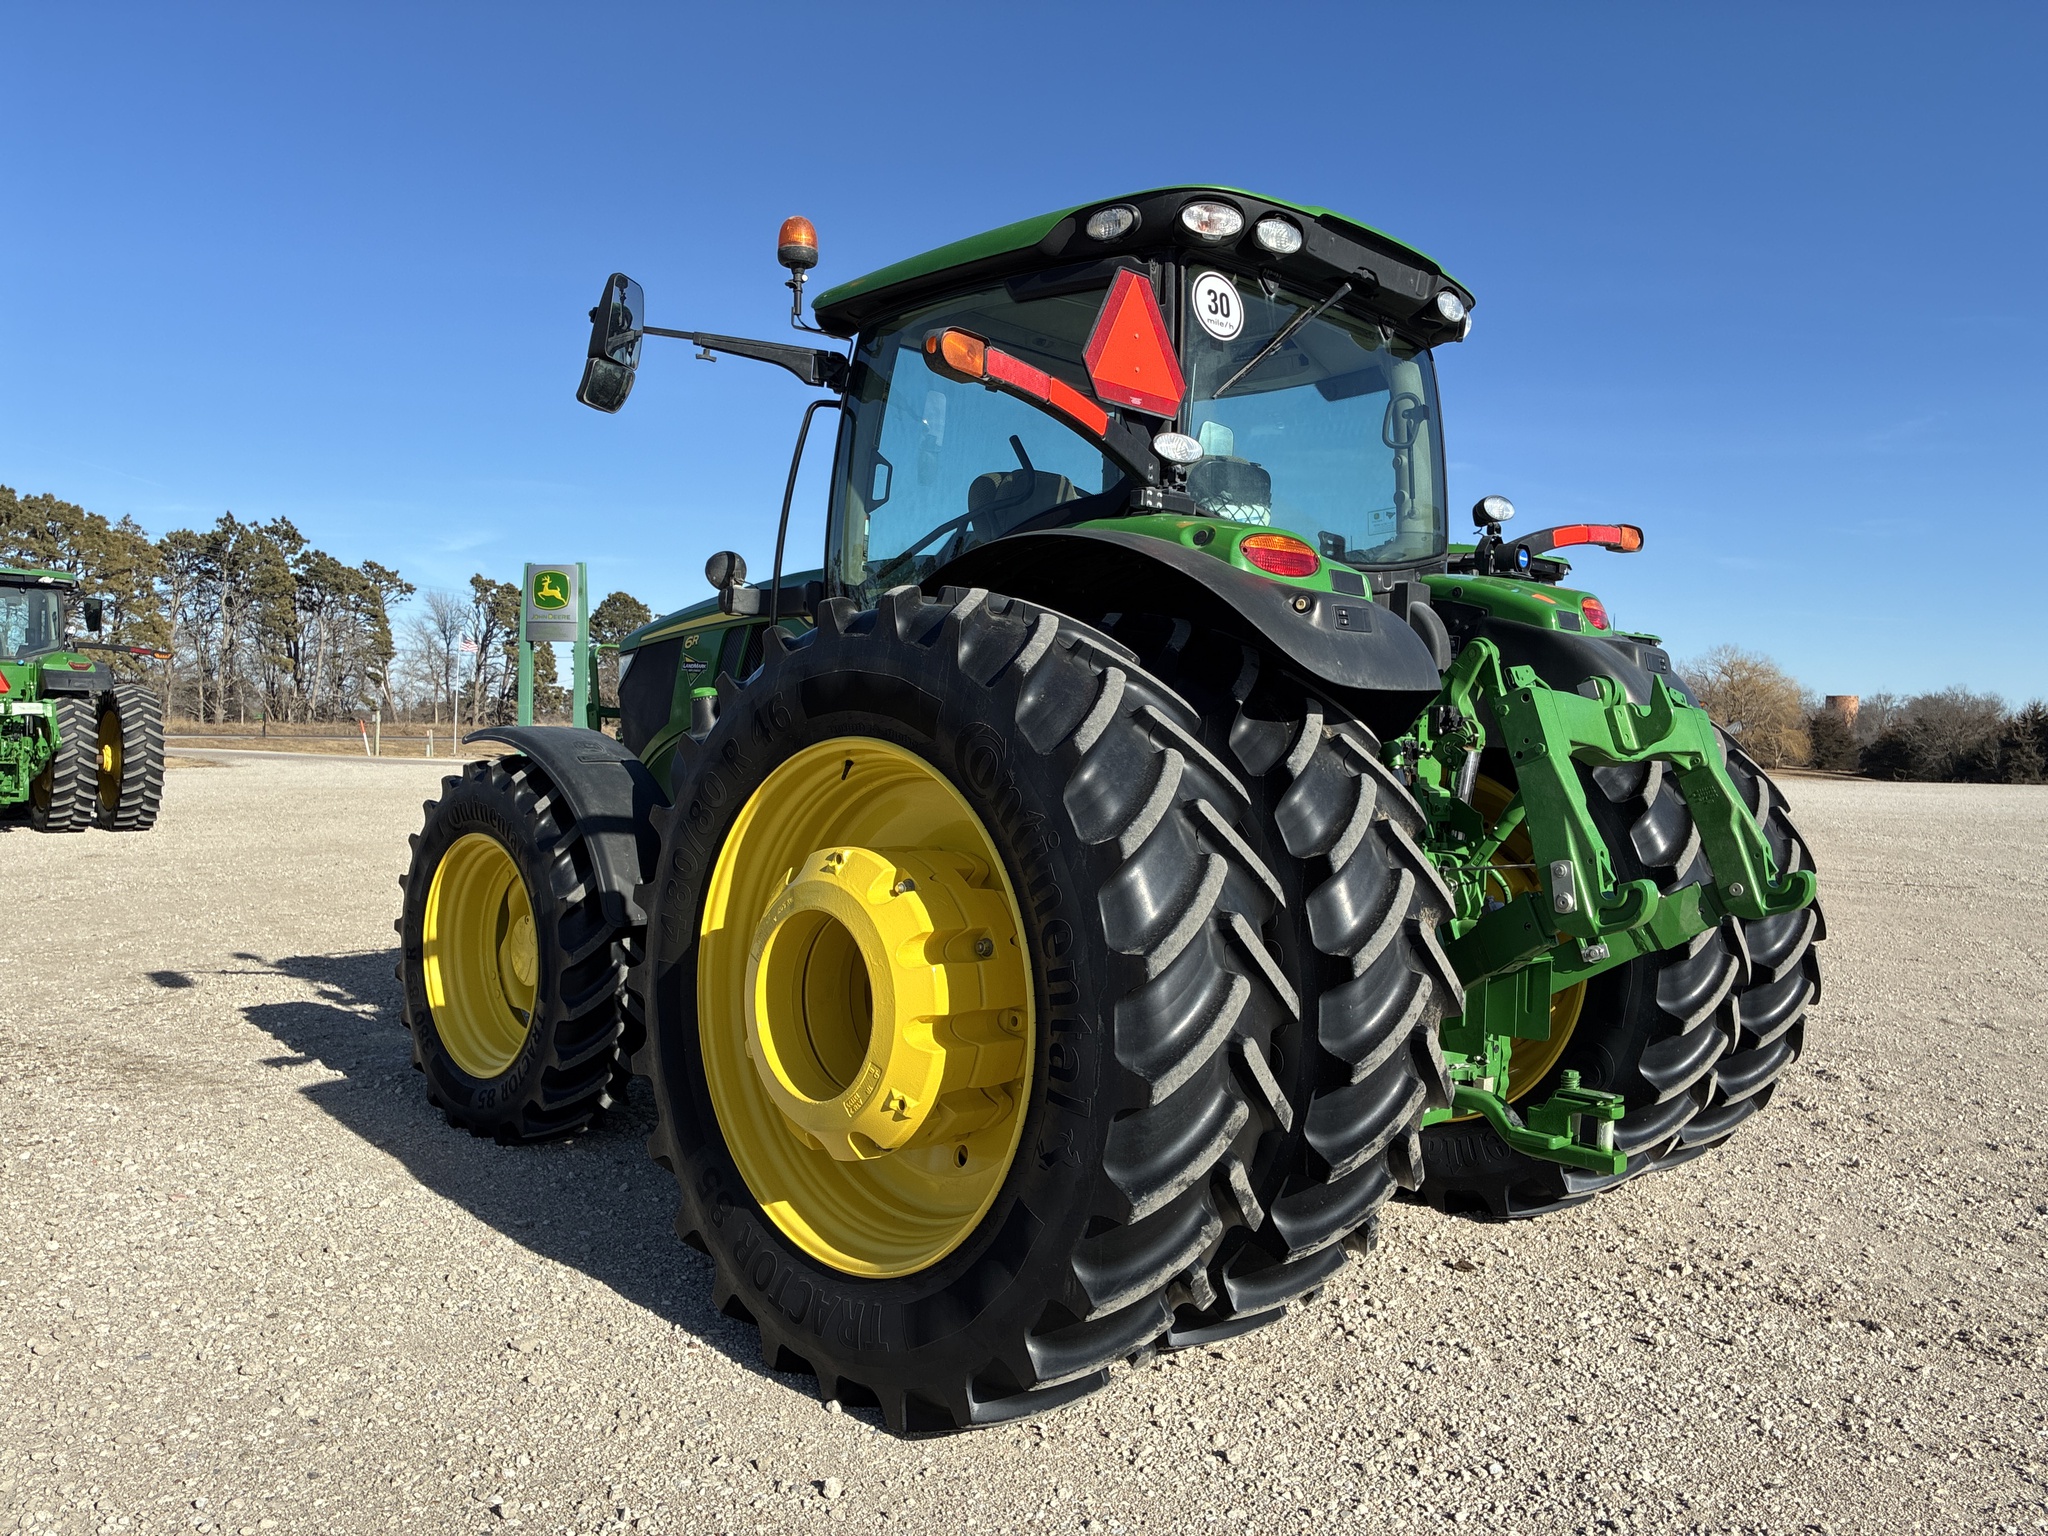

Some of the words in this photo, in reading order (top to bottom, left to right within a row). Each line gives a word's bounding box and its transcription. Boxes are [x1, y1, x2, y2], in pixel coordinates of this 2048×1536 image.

[1207, 289, 1230, 318] 30
[1207, 318, 1234, 330] mile/h
[685, 634, 699, 649] 6R
[660, 771, 728, 944] 480/80
[722, 737, 752, 777] R
[751, 691, 793, 746] 46
[954, 721, 1092, 1119] Continental
[733, 1222, 890, 1352] TRACTOR
